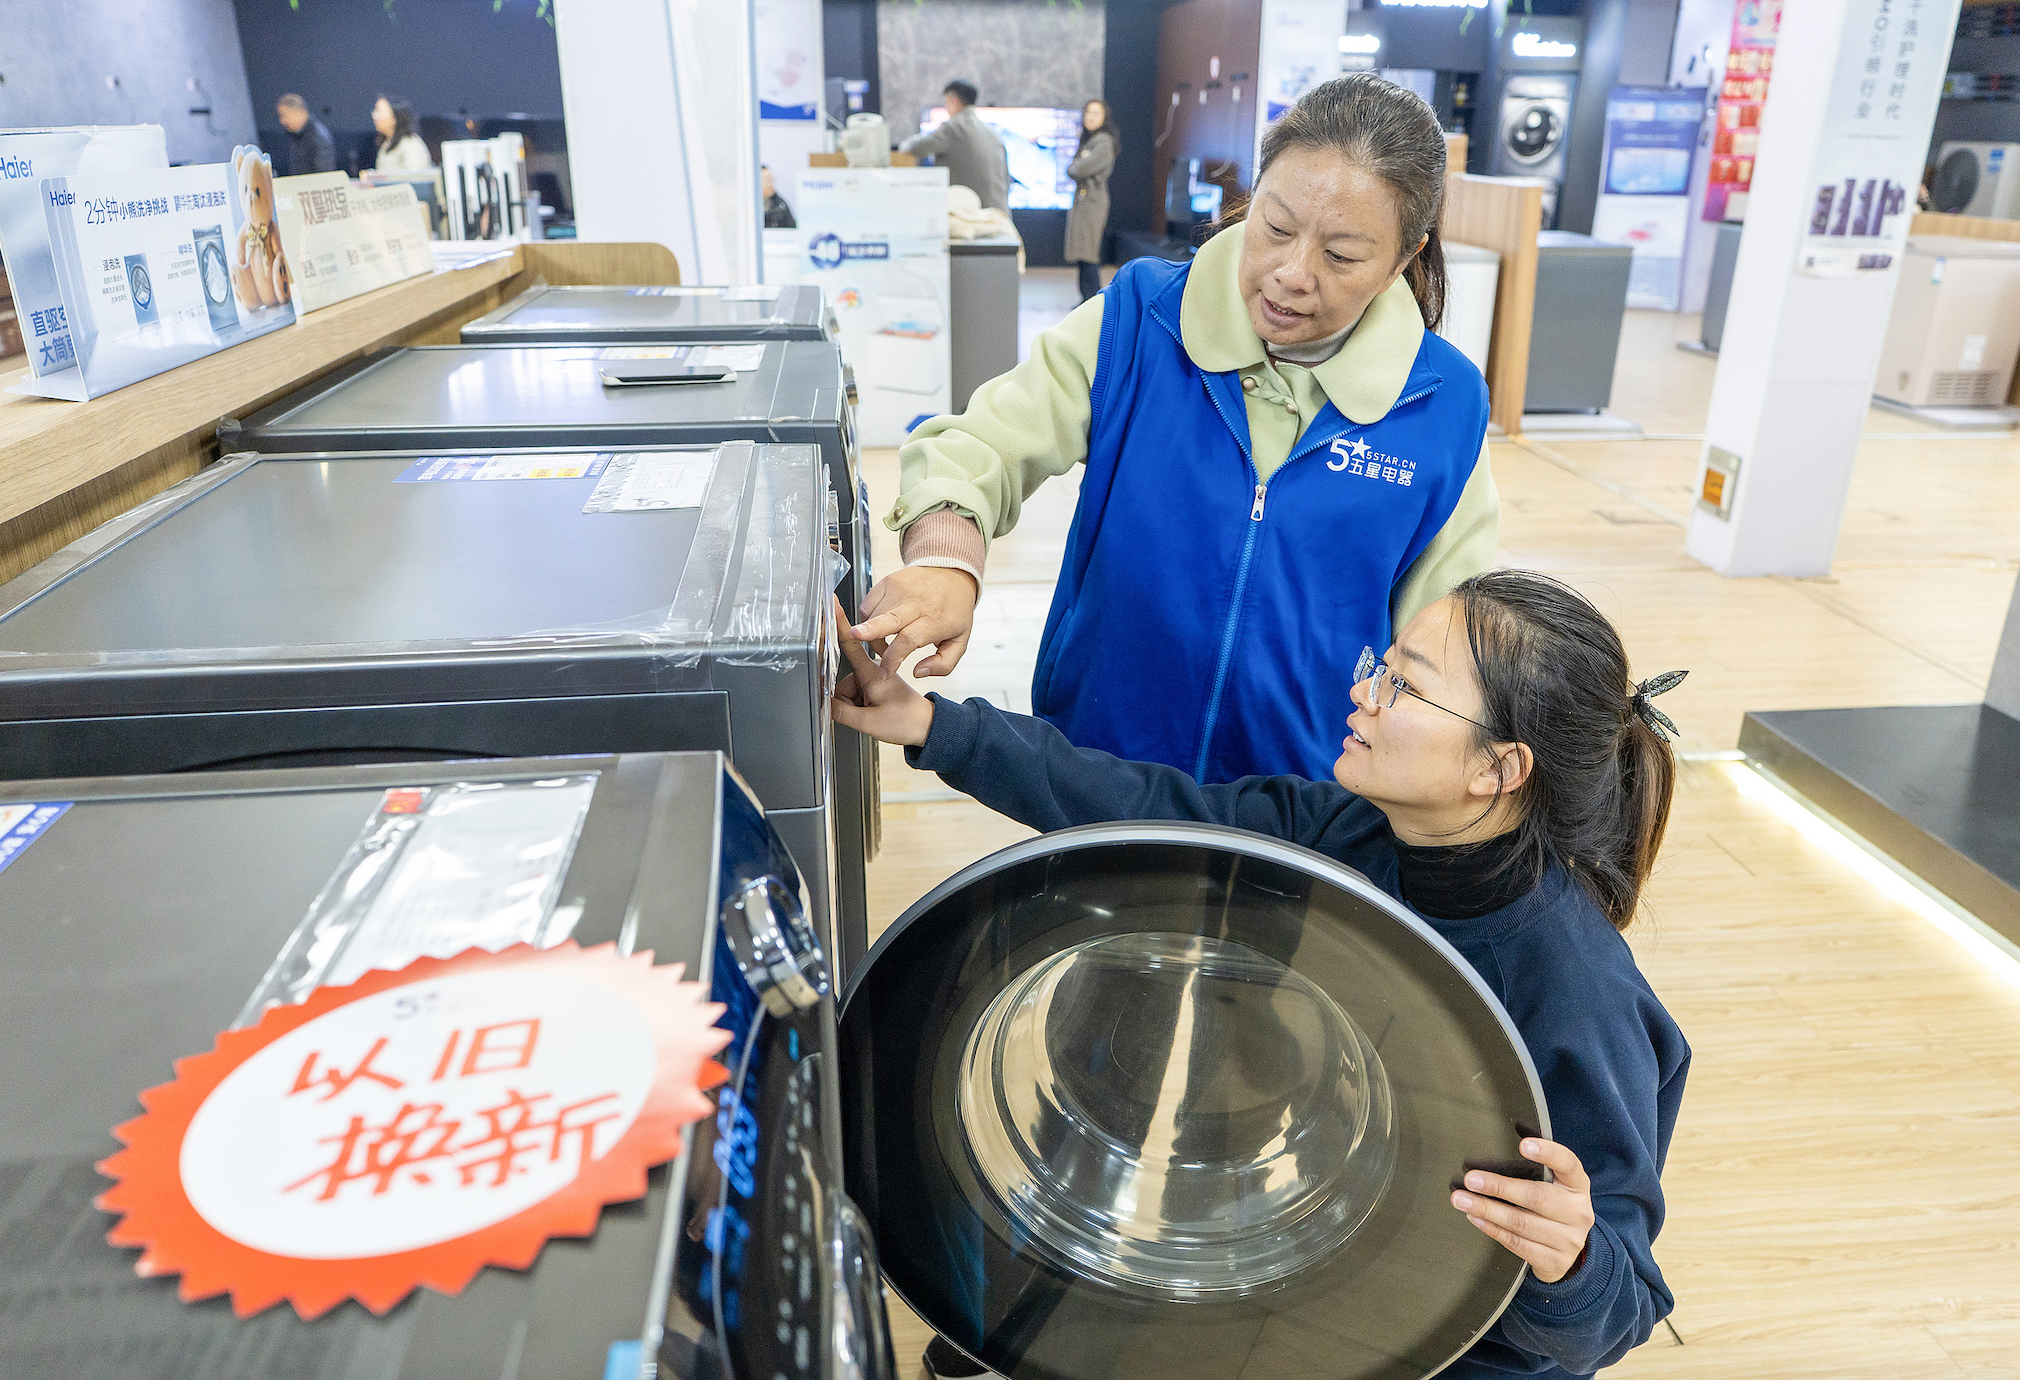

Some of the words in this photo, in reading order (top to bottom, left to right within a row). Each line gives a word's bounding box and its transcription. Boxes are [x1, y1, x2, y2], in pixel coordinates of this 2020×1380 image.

[0, 155, 33, 180] Haier
[50, 190, 76, 207] Haier
[84, 195, 169, 225] 2分钟小熊洗净挑战
[1348, 457, 1414, 487] 五星电器
[1366, 451, 1416, 470] 5STAR.CN
[283, 1017, 542, 1102] 以旧
[282, 1089, 622, 1201] 换新
